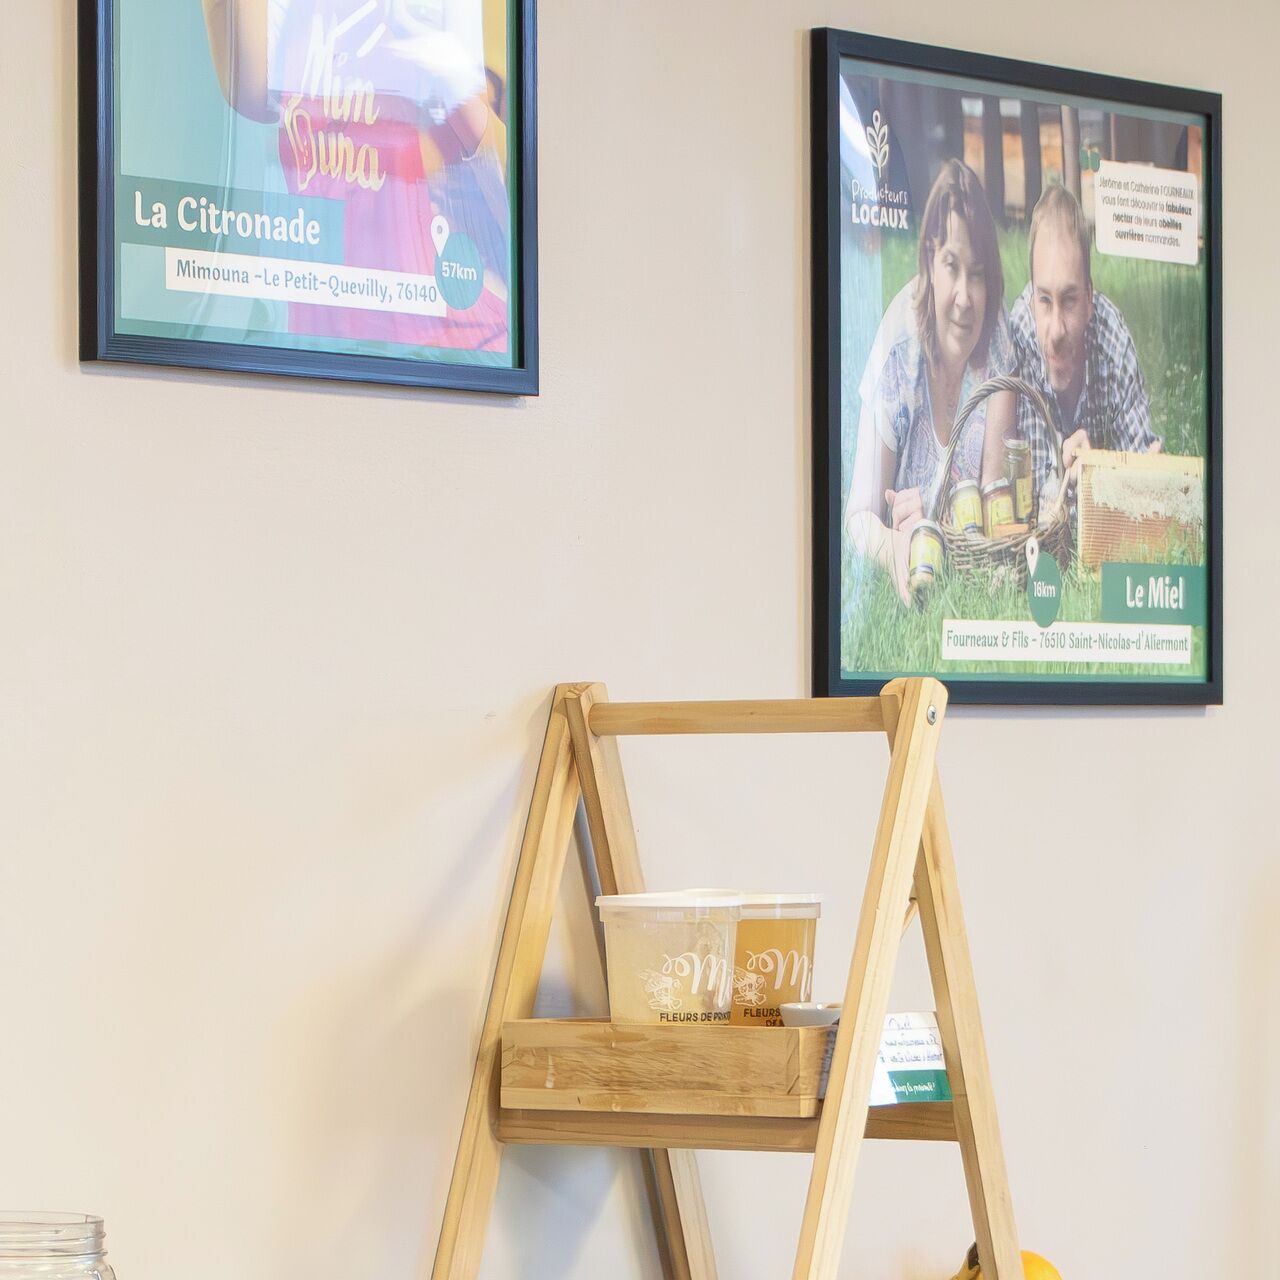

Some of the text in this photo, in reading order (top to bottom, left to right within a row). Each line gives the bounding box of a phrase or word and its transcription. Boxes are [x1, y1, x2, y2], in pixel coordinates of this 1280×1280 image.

[134, 190, 321, 245] La Citronade
[851, 203, 909, 230] LOCAUX
[176, 259, 249, 284] Mimouna
[284, 270, 393, 304] Petit-Quevilly,
[396, 282, 437, 303] 76140
[441, 261, 477, 281] 57km
[1126, 575, 1184, 609] Le Miel
[946, 630, 999, 647] Fourneaux
[1002, 631, 1009, 647] &
[1012, 631, 1029, 648] Fils
[1039, 631, 1065, 648] 76510
[659, 1012, 699, 1022] FLEURS
[701, 1012, 713, 1021] DE
[743, 1007, 781, 1018] FLEURS
